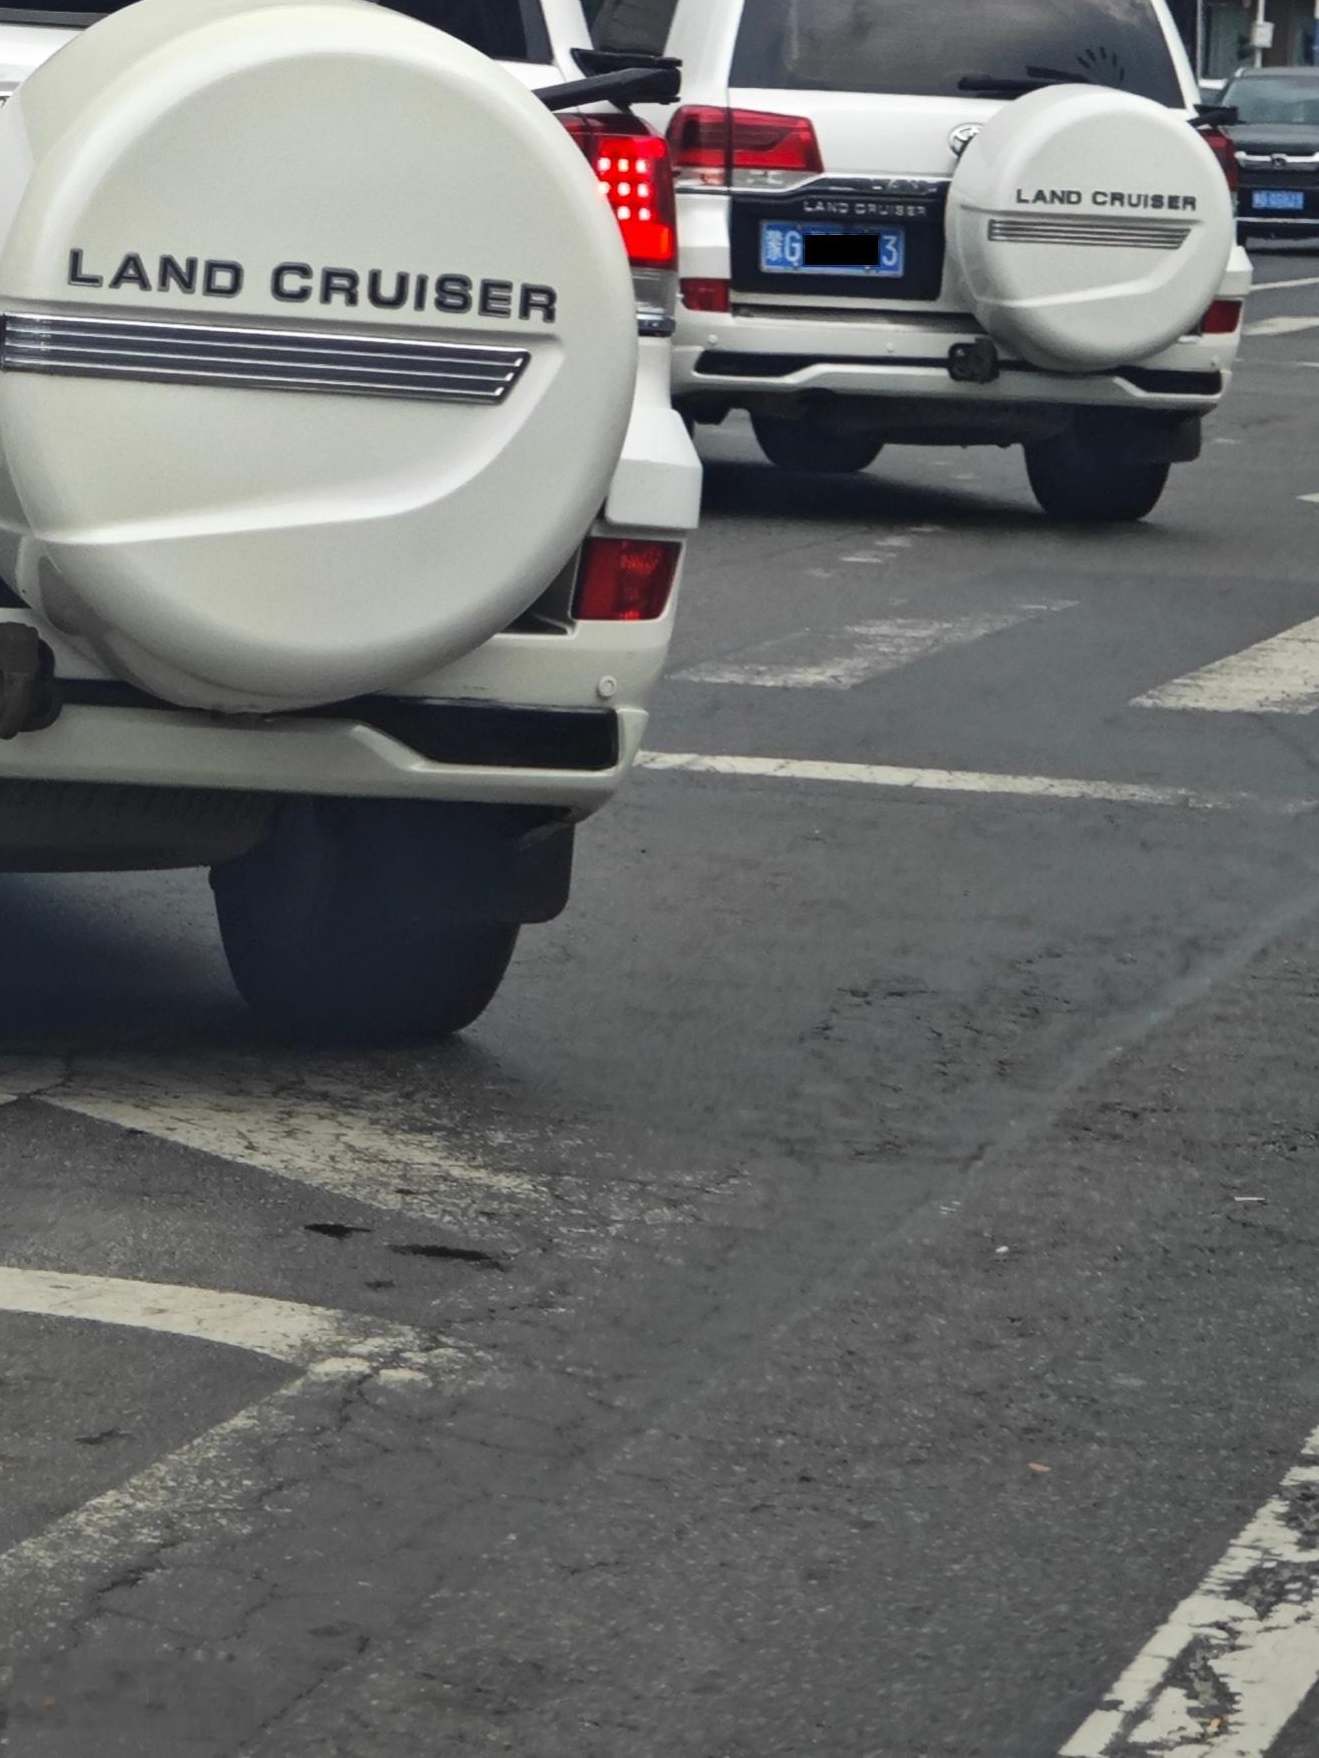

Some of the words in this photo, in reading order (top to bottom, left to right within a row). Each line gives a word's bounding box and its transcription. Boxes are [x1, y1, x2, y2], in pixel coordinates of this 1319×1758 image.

[803, 200, 848, 214] LAND
[854, 203, 927, 217] CRUISER
[1016, 189, 1082, 205] LAND
[1091, 191, 1197, 211] CRUISER
[68, 248, 244, 298] LAND
[270, 261, 558, 323] CRUISER
